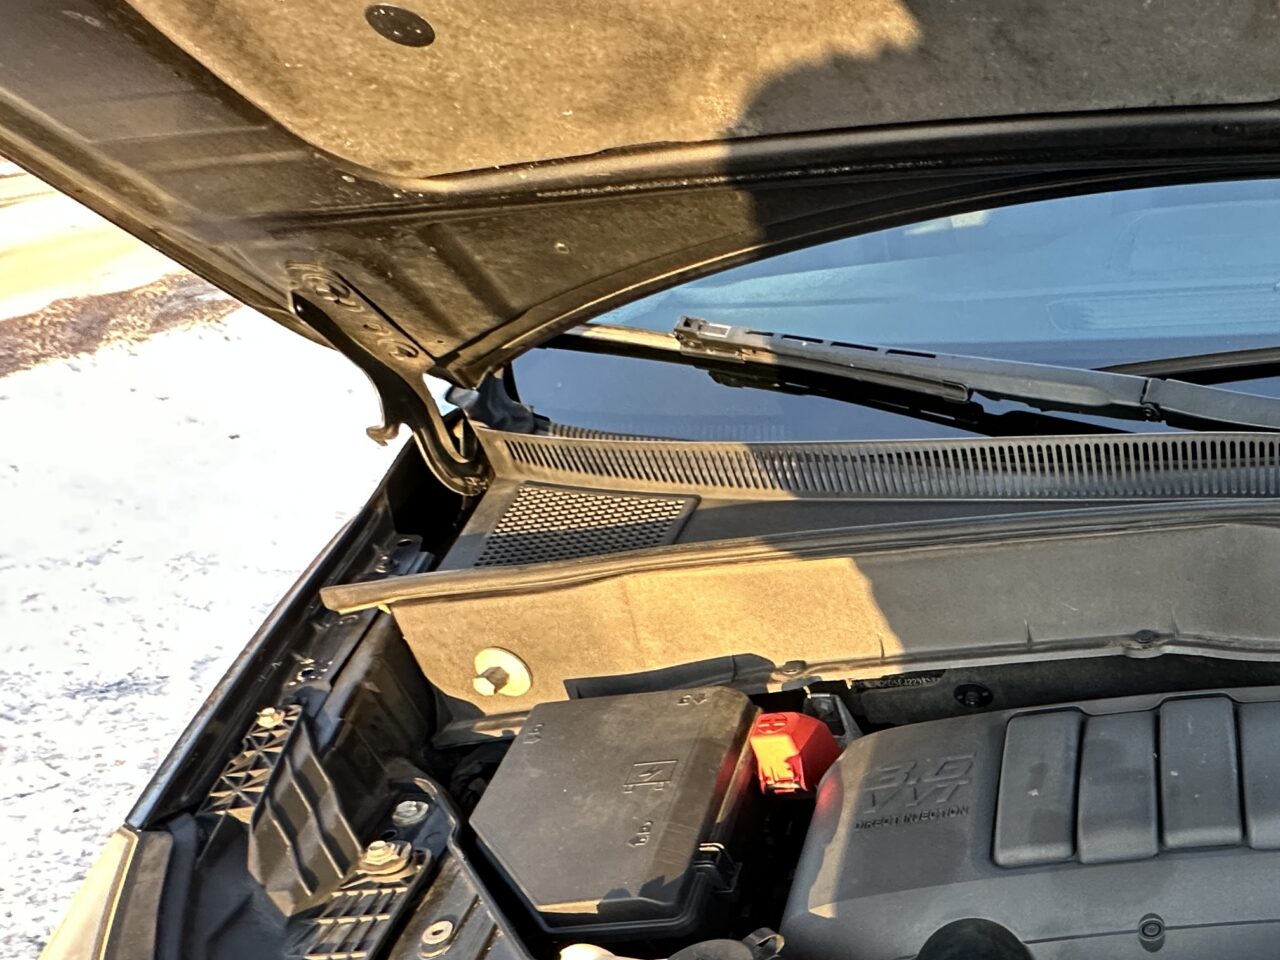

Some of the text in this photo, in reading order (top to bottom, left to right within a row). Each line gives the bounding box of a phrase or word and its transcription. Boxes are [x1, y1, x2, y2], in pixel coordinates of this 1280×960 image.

[864, 752, 977, 791] 3.6
[863, 779, 973, 814] VVT
[855, 806, 969, 829] DIRECT INJECTION
